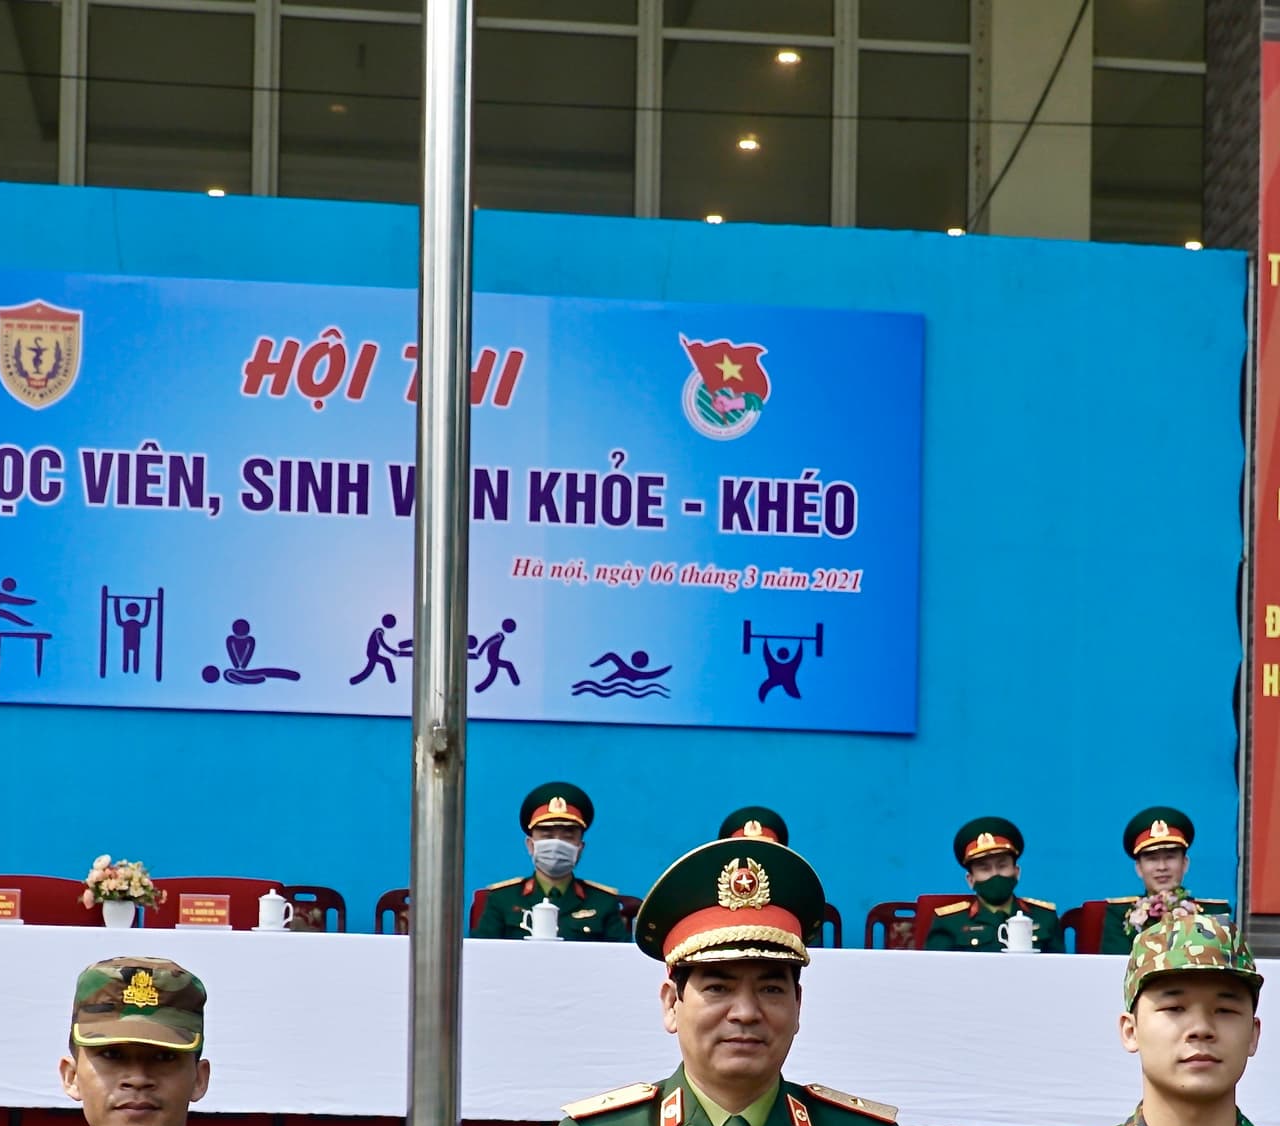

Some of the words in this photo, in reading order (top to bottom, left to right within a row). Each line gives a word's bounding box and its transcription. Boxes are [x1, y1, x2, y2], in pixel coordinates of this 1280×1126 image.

[242, 328, 377, 410] HỘI
[81, 442, 220, 516] VIÊN,
[241, 459, 369, 516] SINH
[389, 465, 508, 521] VN
[529, 451, 664, 528] KHỎE
[721, 471, 856, 536] KHÉO
[512, 558, 544, 577] Hà
[550, 560, 589, 583] nội,
[596, 564, 644, 586] ngày
[650, 563, 673, 582] 06
[681, 565, 738, 589] tháng
[744, 567, 756, 587] 3
[763, 567, 808, 589] năm
[814, 570, 863, 591] 2021
